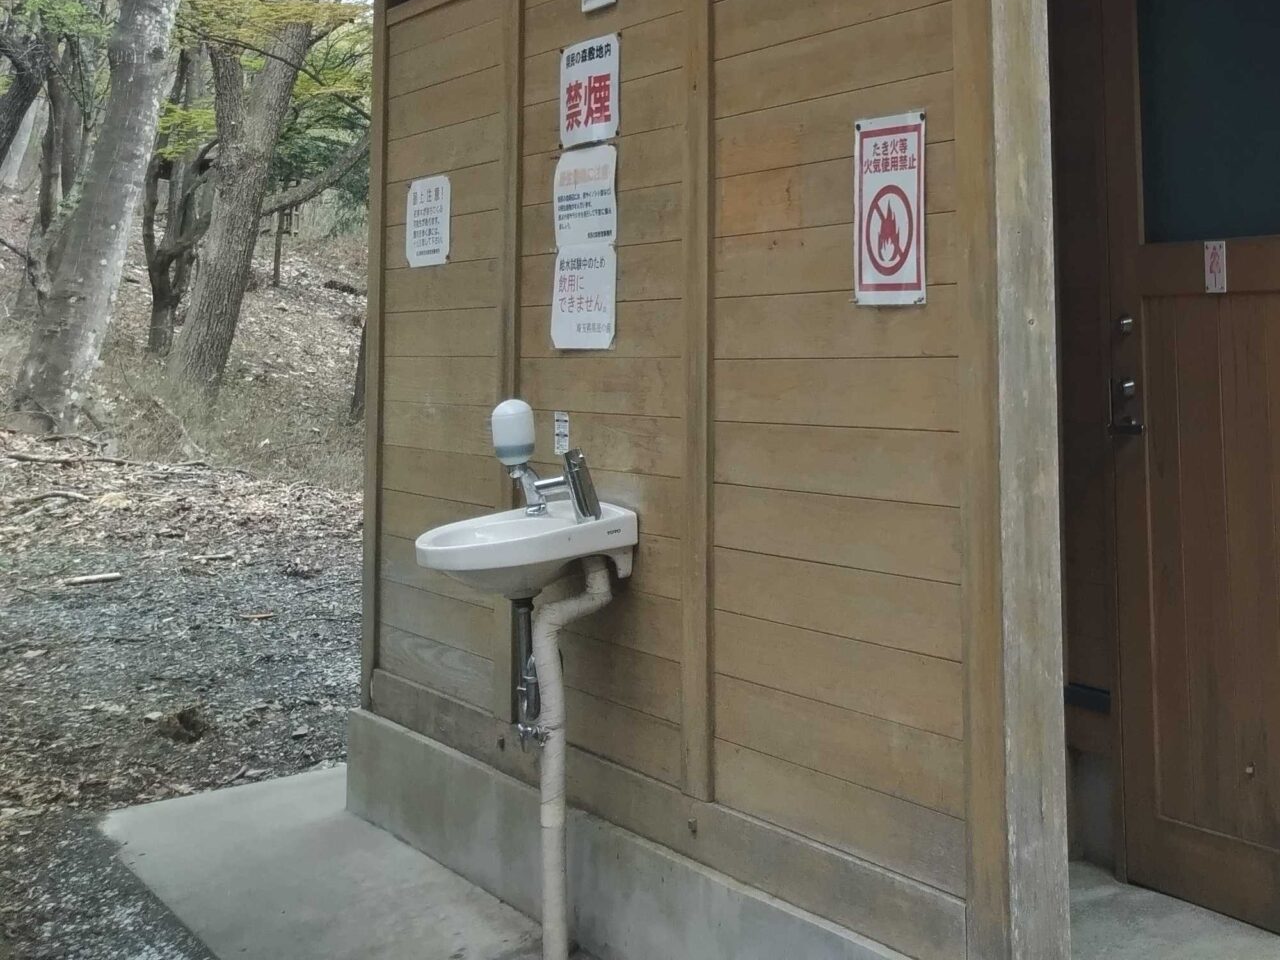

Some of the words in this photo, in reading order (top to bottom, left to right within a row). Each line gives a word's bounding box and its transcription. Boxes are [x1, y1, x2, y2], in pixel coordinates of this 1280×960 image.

[566, 73, 611, 133] 禁煙
[873, 138, 908, 157] たき火等
[864, 154, 917, 175] 火気使用禁止
[558, 274, 585, 293] 飲用に
[558, 294, 608, 313] できません。
